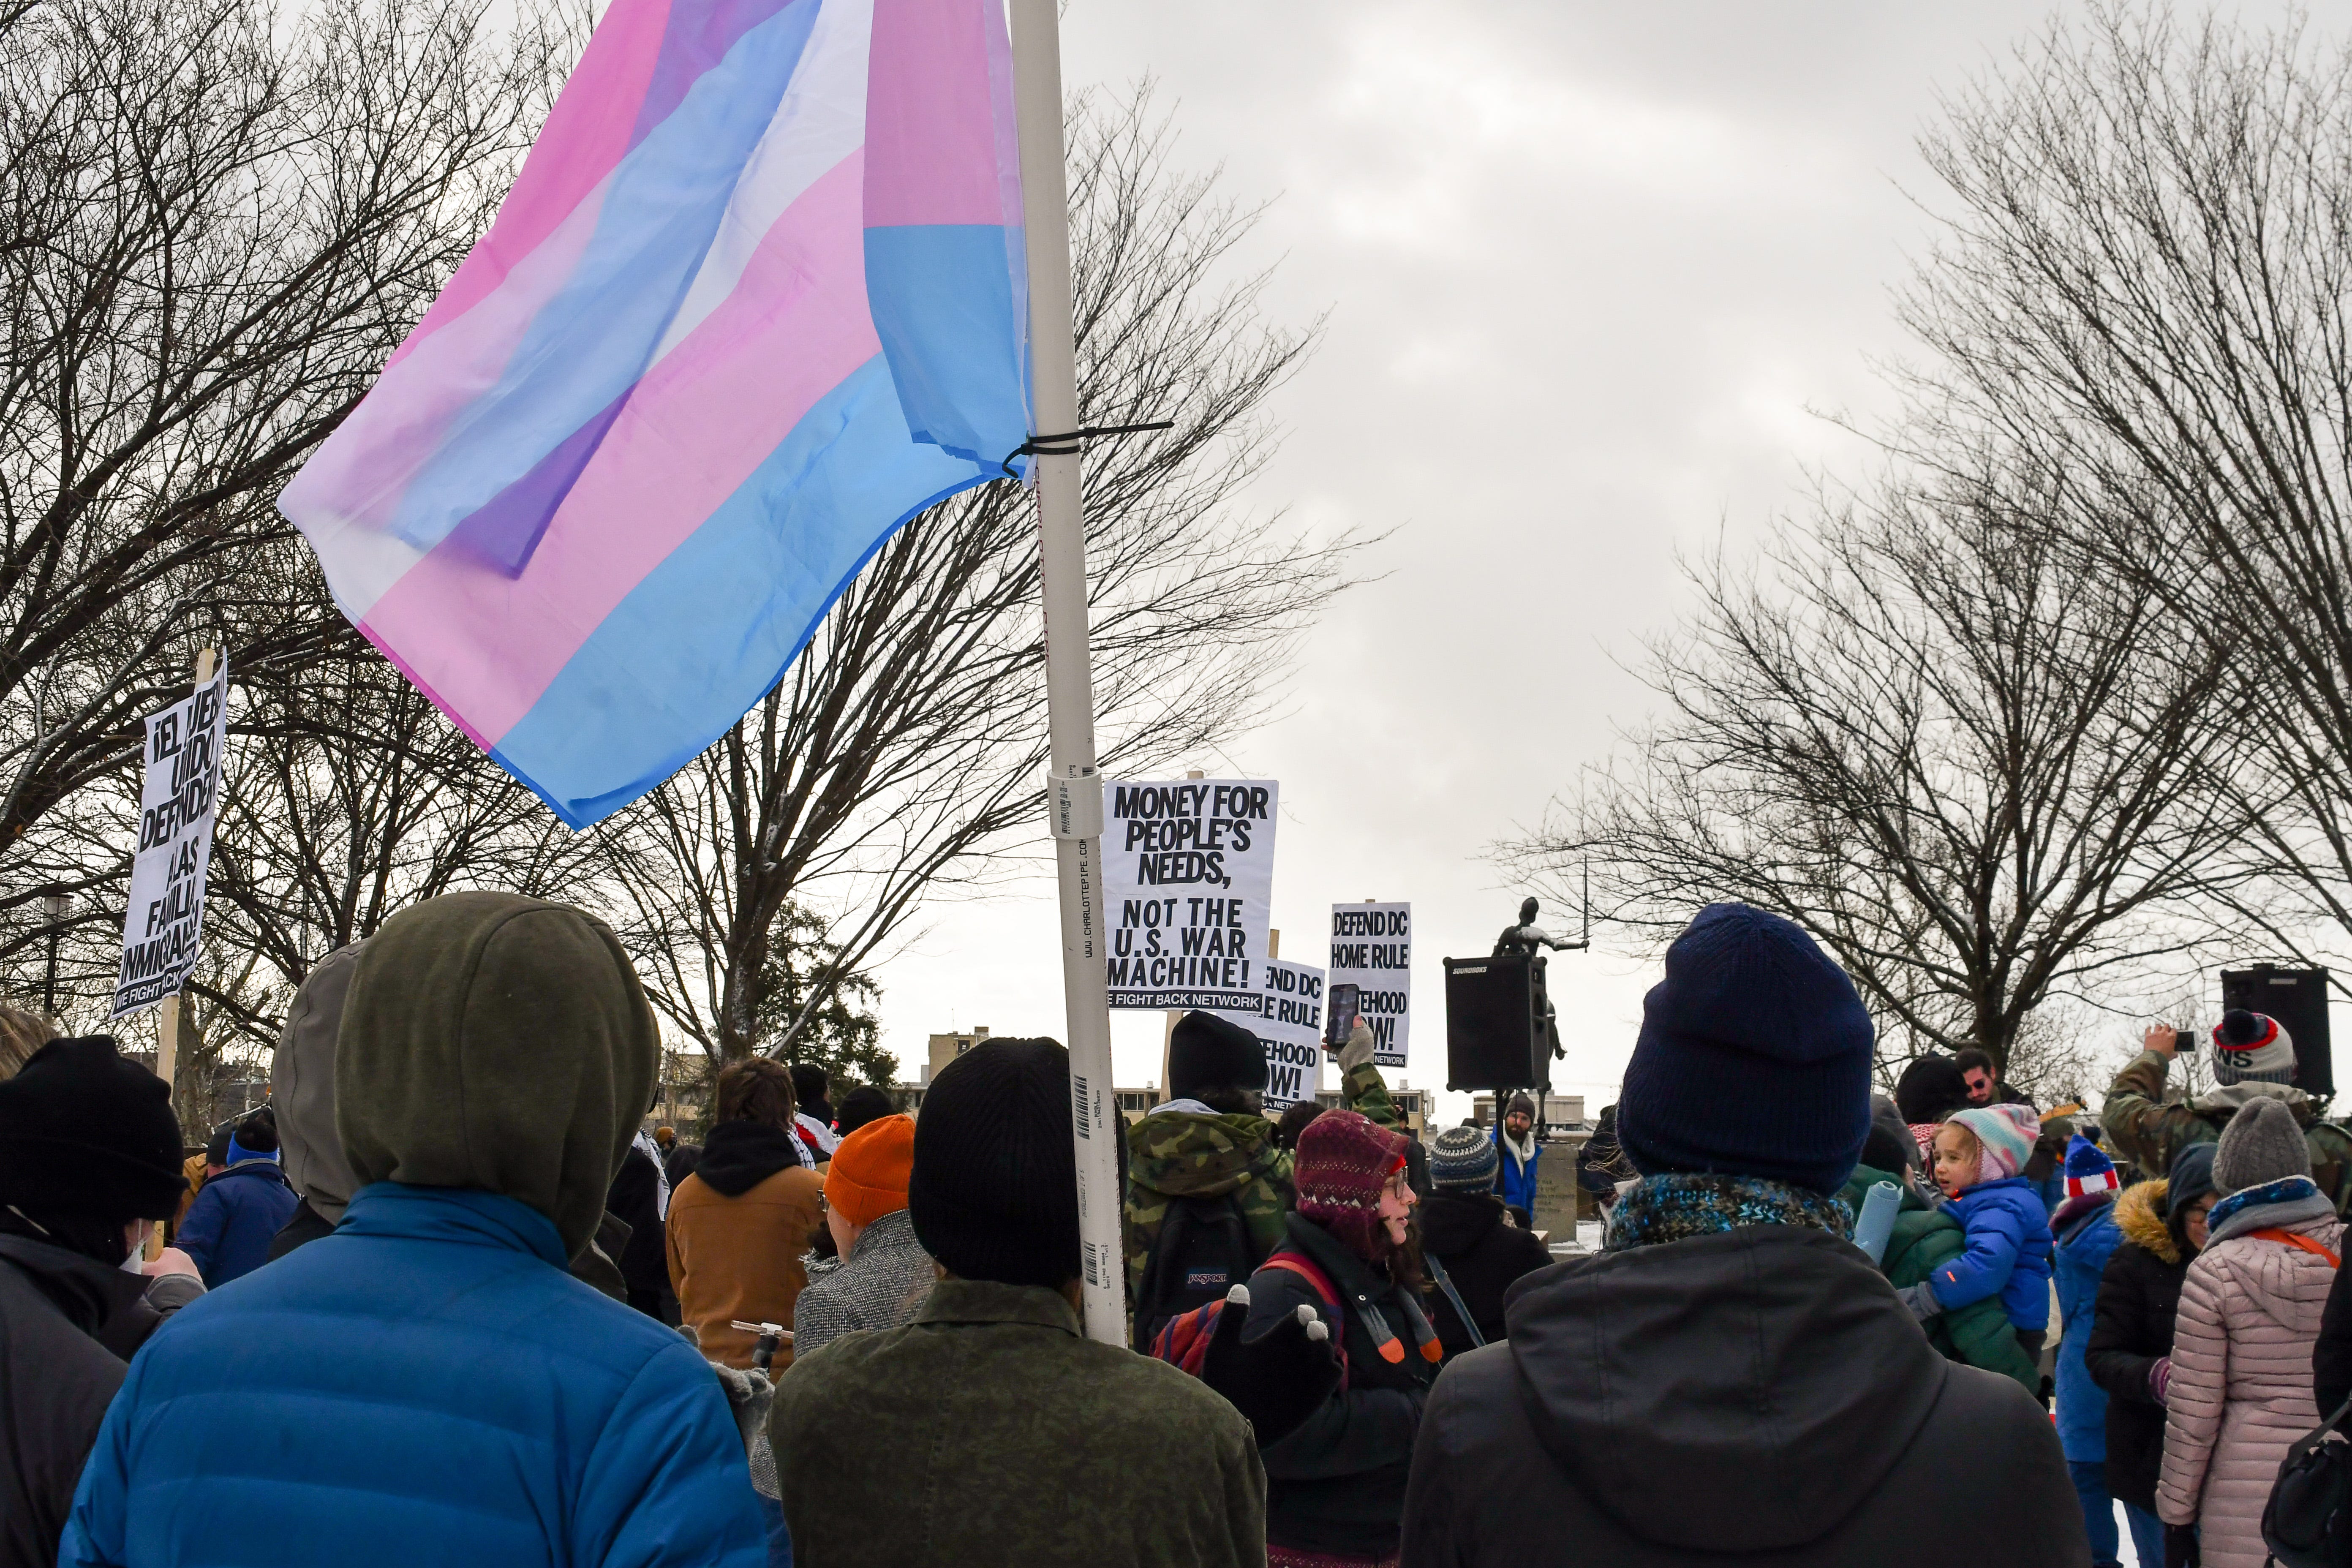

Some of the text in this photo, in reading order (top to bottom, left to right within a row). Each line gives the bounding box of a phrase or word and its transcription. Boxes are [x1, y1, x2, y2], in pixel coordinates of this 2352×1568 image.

[153, 712, 182, 764] ¡EL
[172, 725, 215, 796] UIDO
[1114, 784, 1268, 819] MONEY FOR
[1138, 851, 1231, 889] NEEDS,
[1122, 898, 1243, 928] NOT THE
[1334, 911, 1408, 936] DEFEND DC
[1115, 928, 1246, 958] U.S. WAR
[1331, 943, 1409, 969] HOME RULE
[1108, 957, 1250, 988] MACHINE!
[1266, 966, 1321, 999] END DC
[116, 971, 180, 1009] WE FIGHT ACK
[1116, 994, 1154, 1005] FIGHT
[1156, 993, 1190, 1005] BACK
[1192, 994, 1260, 1008] NETWORK
[1359, 990, 1407, 1015] EHOOD
[1278, 999, 1320, 1030] RULE
[1361, 1016, 1395, 1051] W!
[1258, 1037, 1316, 1068] EHOOD
[1375, 1055, 1404, 1065] NETWORK
[1270, 1063, 1302, 1099] W!
[1188, 1274, 1227, 1284] JANSPORT
